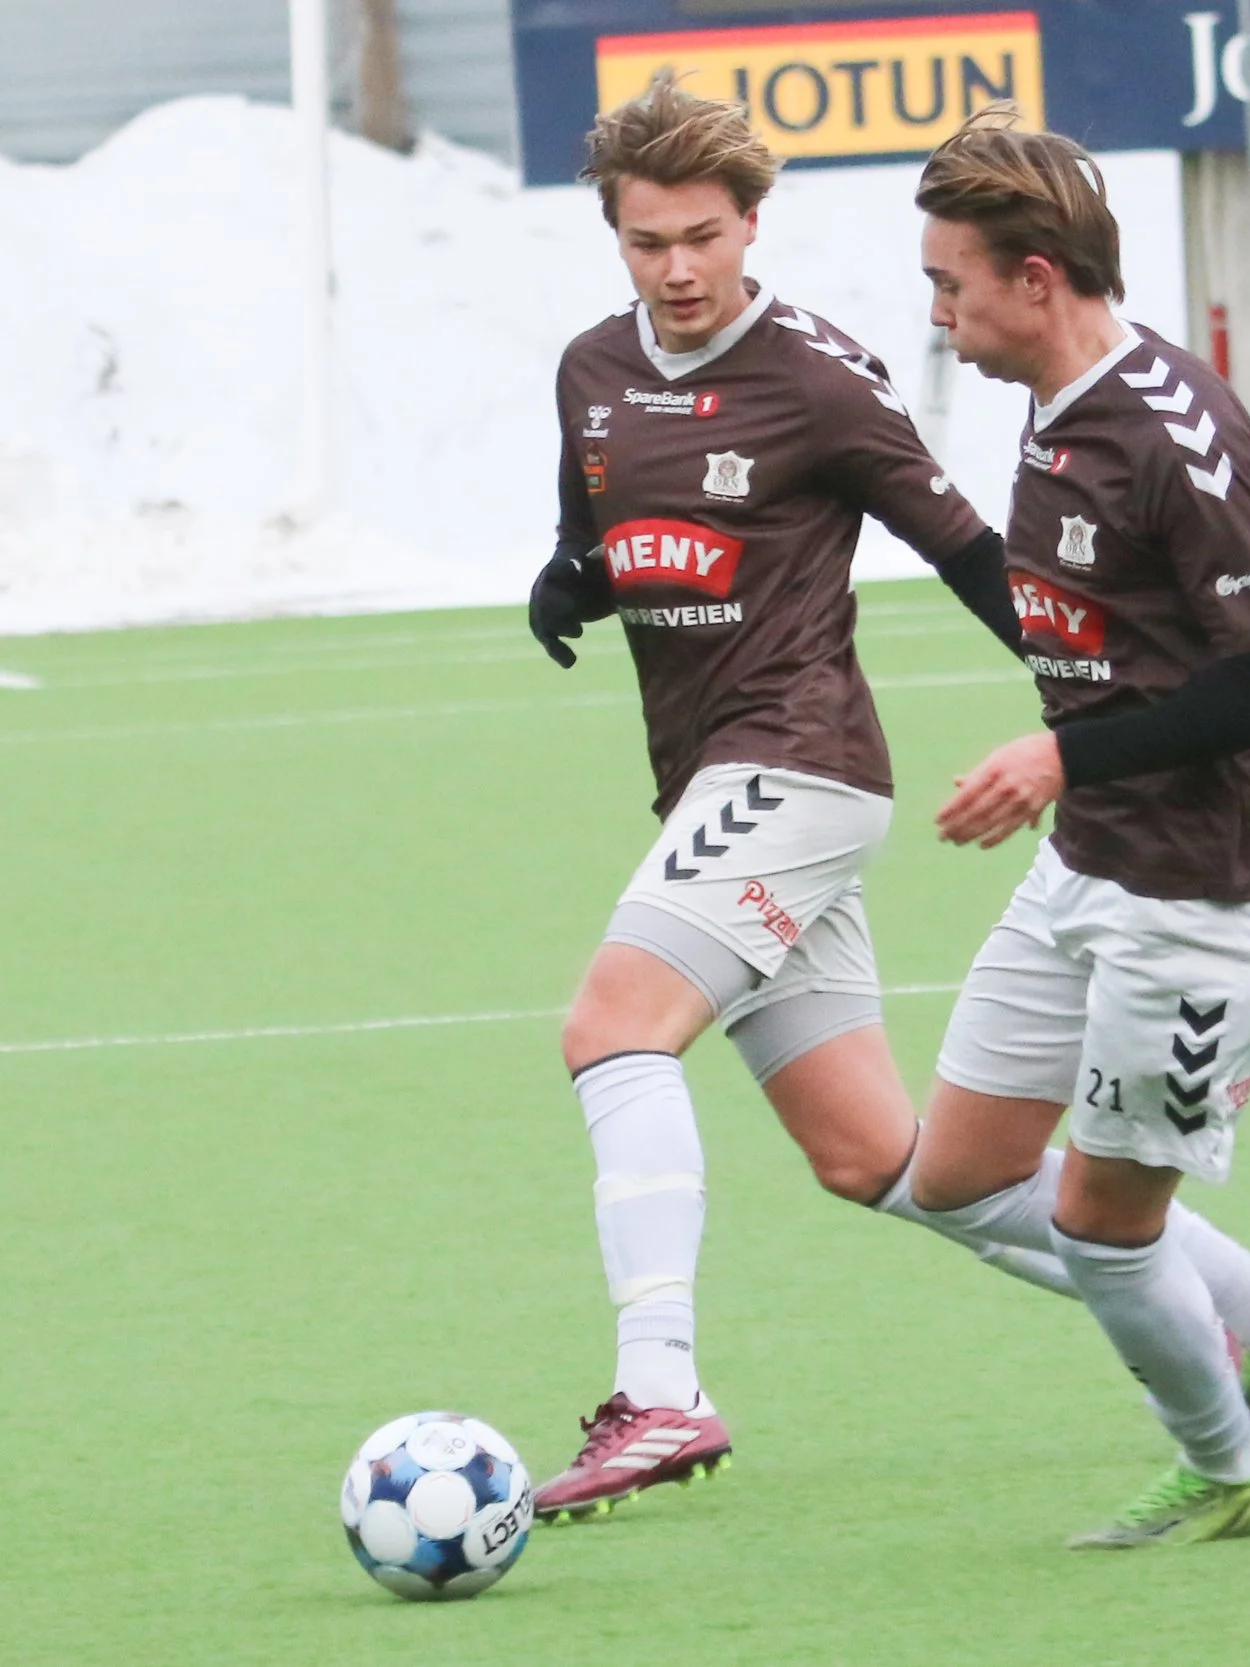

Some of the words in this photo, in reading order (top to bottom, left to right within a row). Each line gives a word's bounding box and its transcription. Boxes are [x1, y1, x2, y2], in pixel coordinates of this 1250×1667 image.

[623, 387, 696, 407] SpareBank
[701, 395, 714, 413] 1
[607, 534, 725, 579] MENY
[1085, 1068, 1124, 1113] 21
